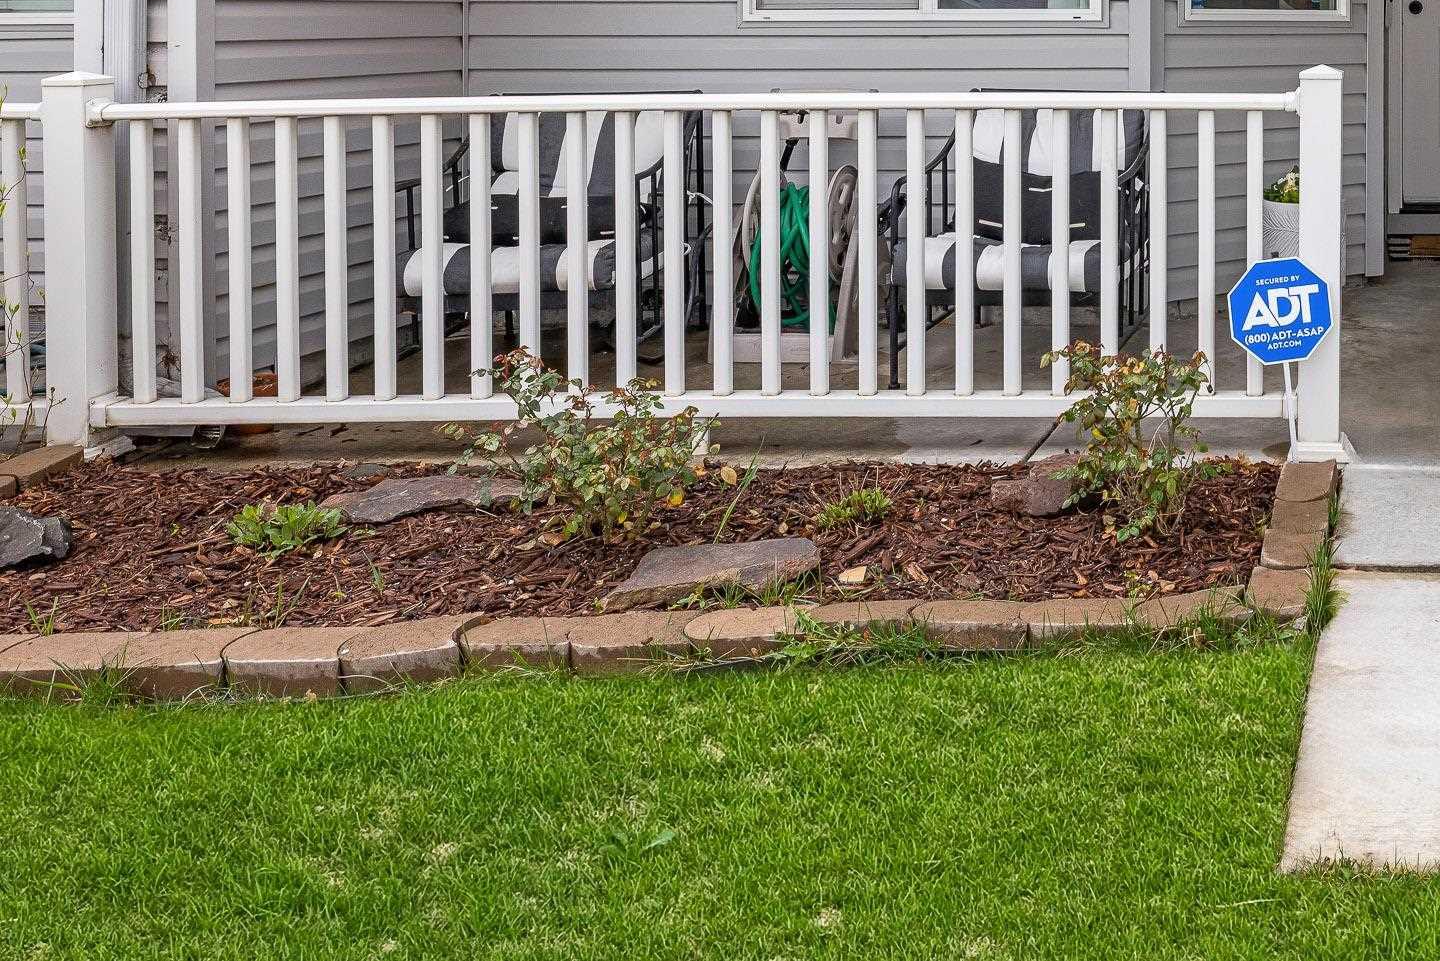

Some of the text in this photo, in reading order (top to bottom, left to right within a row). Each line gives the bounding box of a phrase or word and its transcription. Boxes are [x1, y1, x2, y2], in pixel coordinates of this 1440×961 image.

[1255, 276, 1289, 286] SECURED
[1242, 284, 1319, 331] ADT
[1245, 327, 1324, 345] (800) ADT-ASAP
[1267, 340, 1302, 351] ADT.COM
